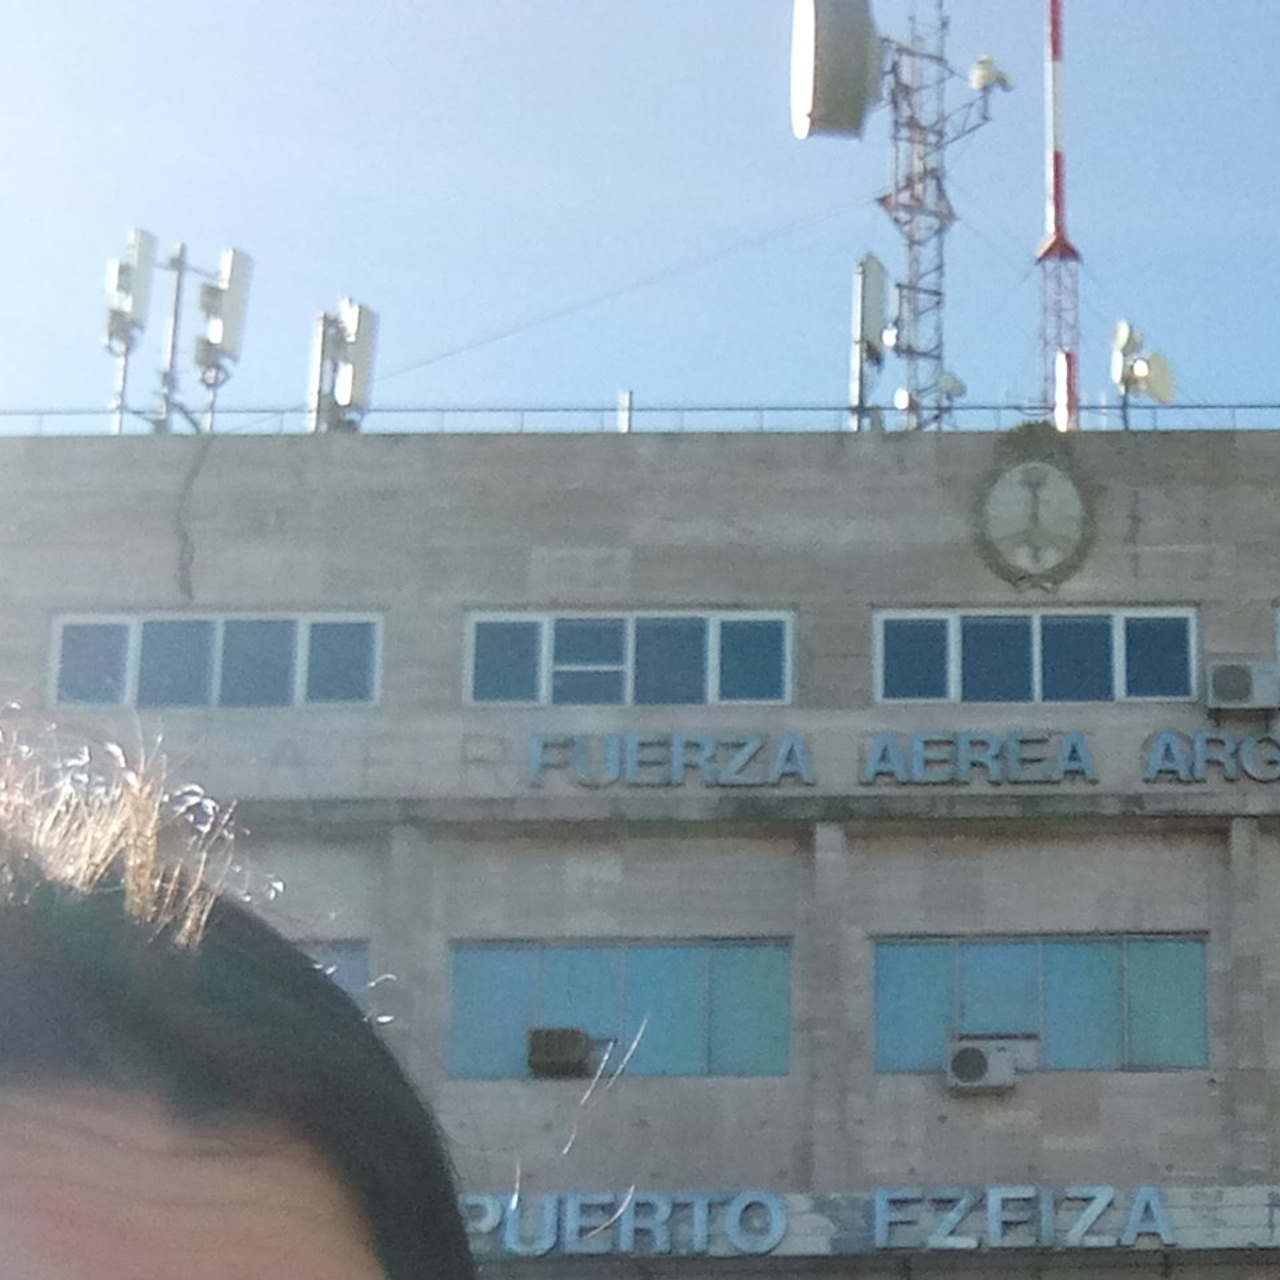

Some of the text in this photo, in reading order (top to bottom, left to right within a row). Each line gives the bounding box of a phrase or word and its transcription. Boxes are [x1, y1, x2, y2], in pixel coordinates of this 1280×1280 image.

[527, 731, 816, 789] FUERZA
[858, 730, 1098, 787] AEREA
[874, 1184, 1178, 1249] EZEIZA
